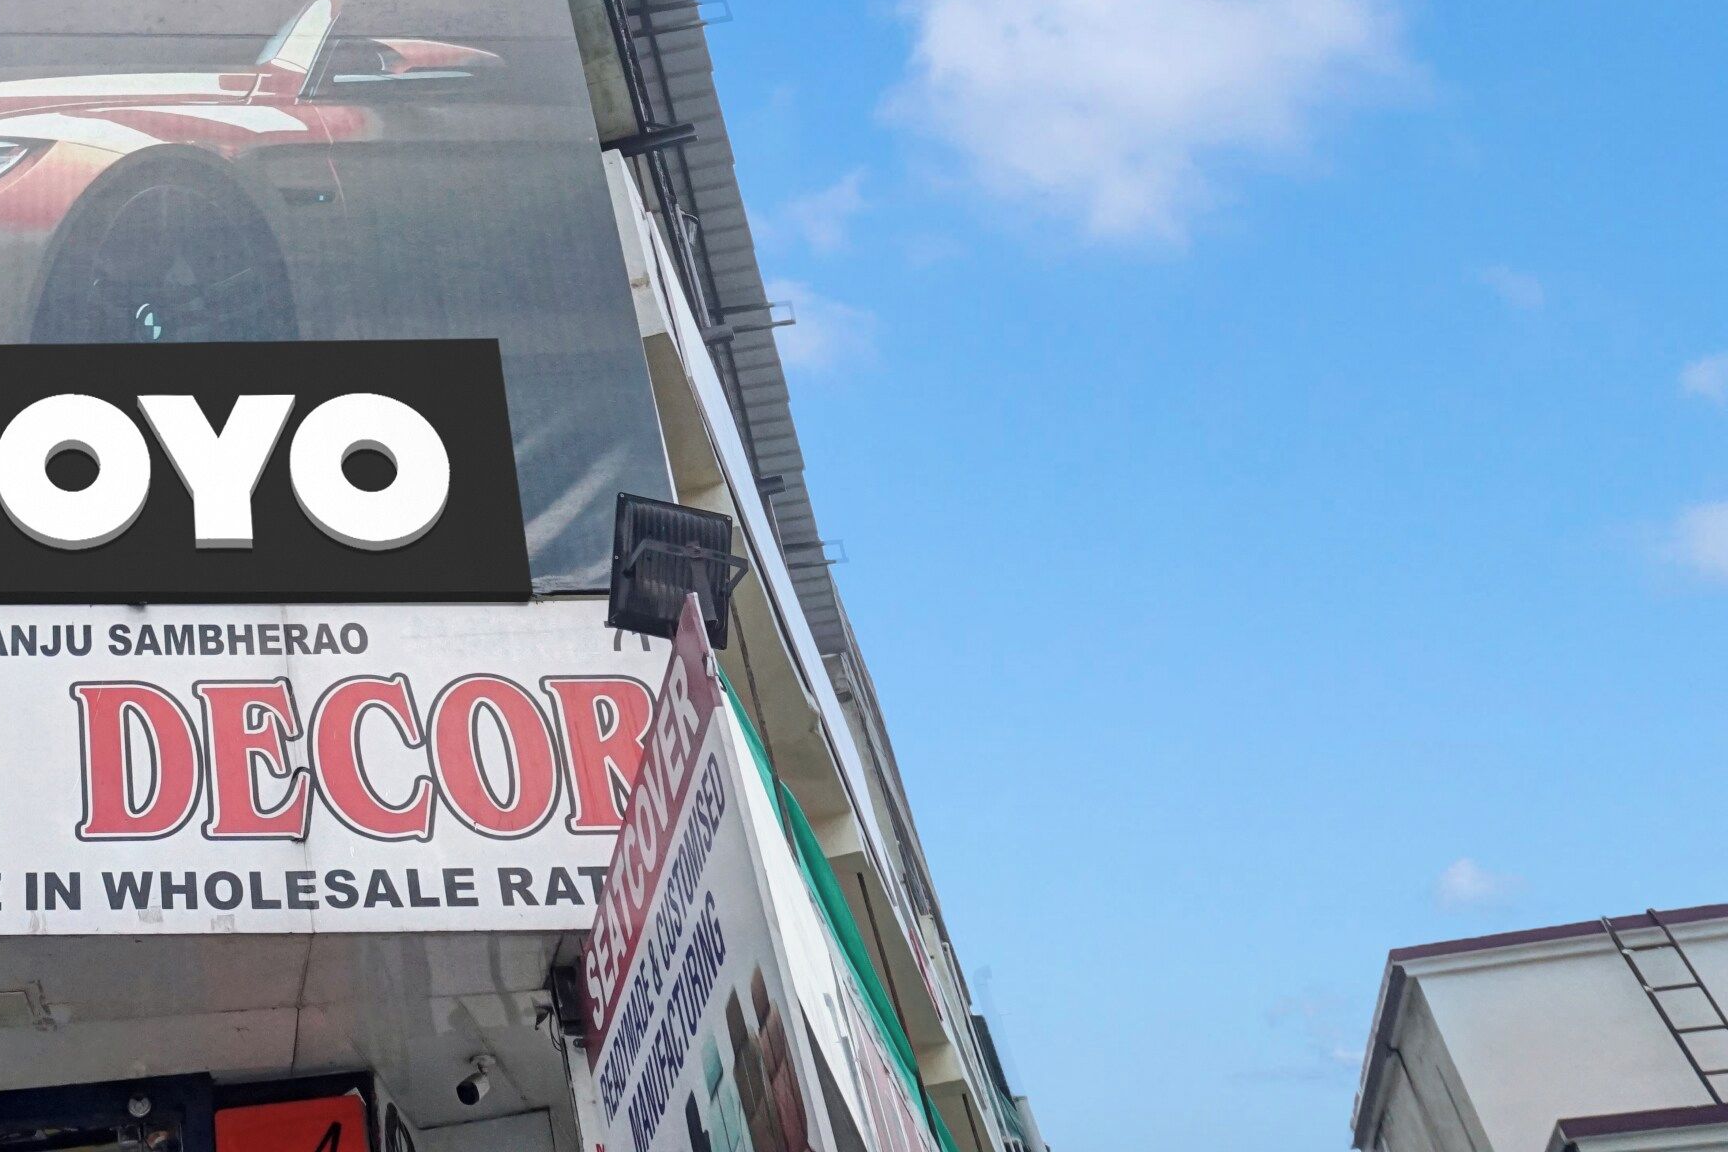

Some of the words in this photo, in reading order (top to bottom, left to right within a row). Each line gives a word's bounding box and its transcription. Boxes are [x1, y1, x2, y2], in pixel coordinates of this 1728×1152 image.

[108, 622, 369, 658] SAMBHERAO
[69, 671, 658, 842] DECOR
[25, 870, 81, 912] IN
[100, 867, 481, 911] WHOLESALE
[502, 866, 609, 908] RAT
[655, 751, 726, 972] CUSTOMISED
[599, 958, 655, 1129] READYMADE
[628, 890, 727, 1152] MANUFACTURING
[647, 938, 664, 996] &
